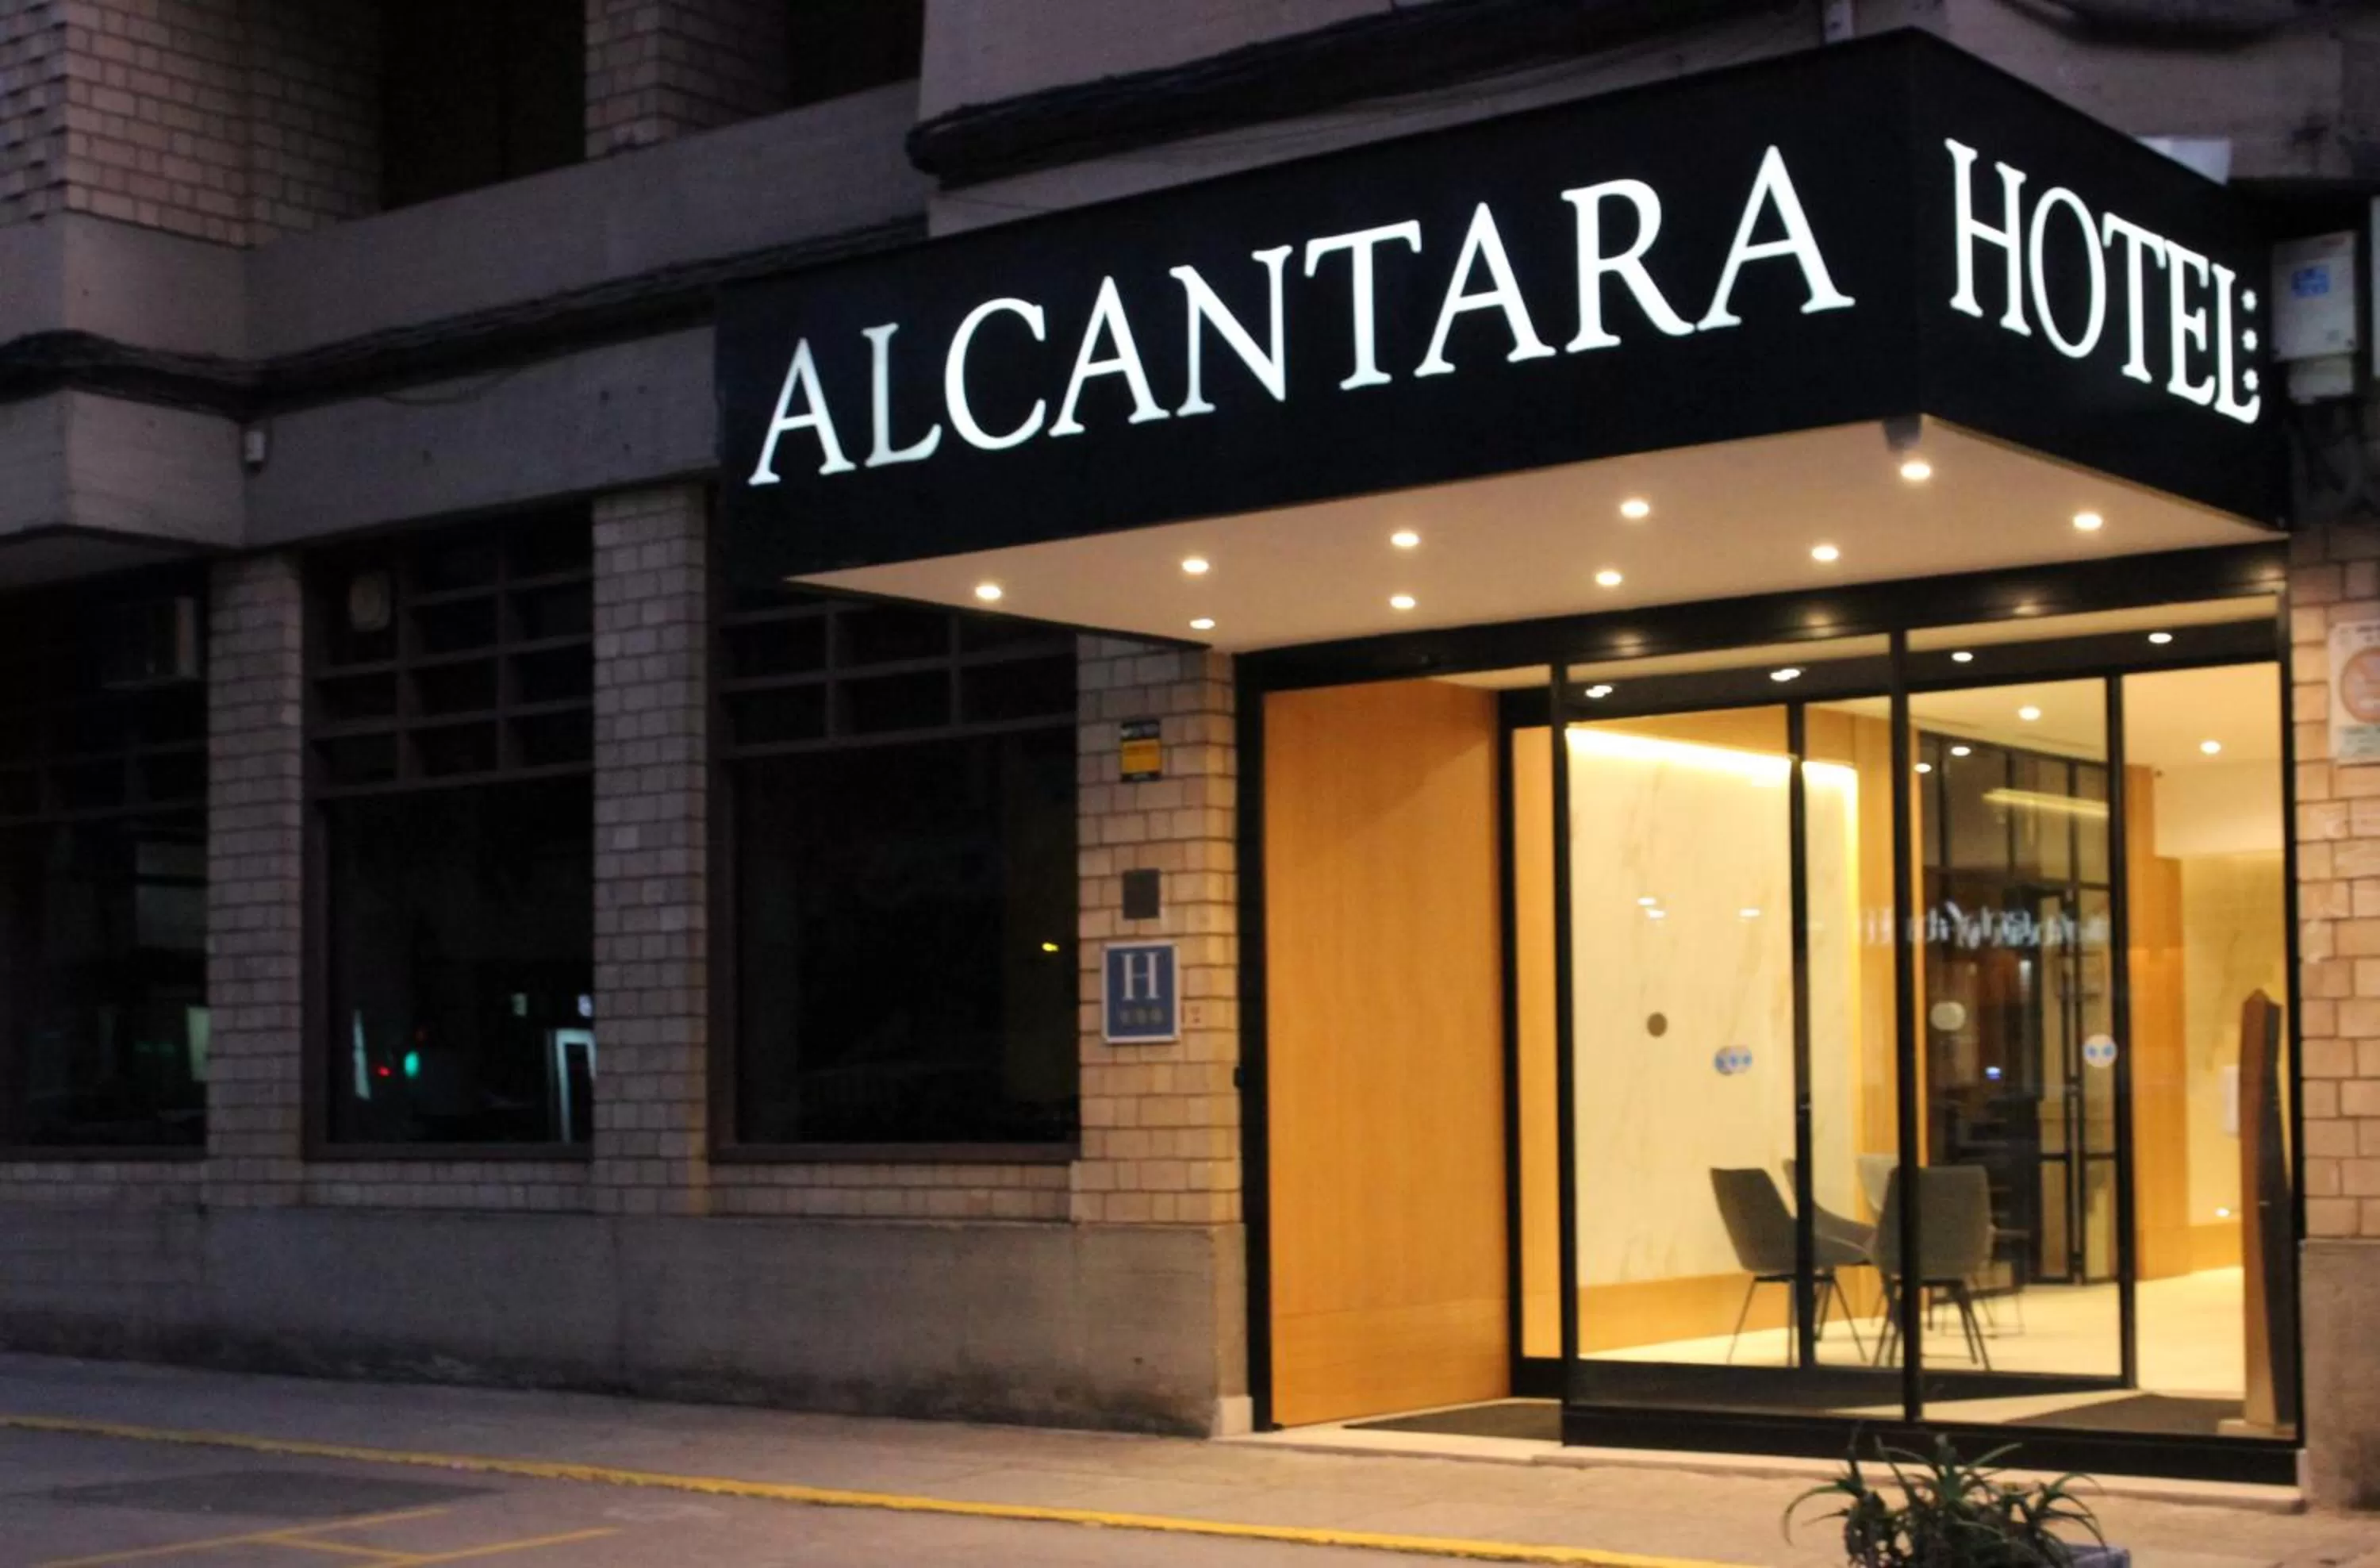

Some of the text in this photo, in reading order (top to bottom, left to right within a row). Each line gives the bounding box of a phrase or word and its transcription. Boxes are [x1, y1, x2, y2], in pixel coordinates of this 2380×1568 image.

[748, 145, 1855, 486] ALCANTARA
[1944, 137, 2261, 424] HOTEL
[1121, 951, 1161, 1001] H
